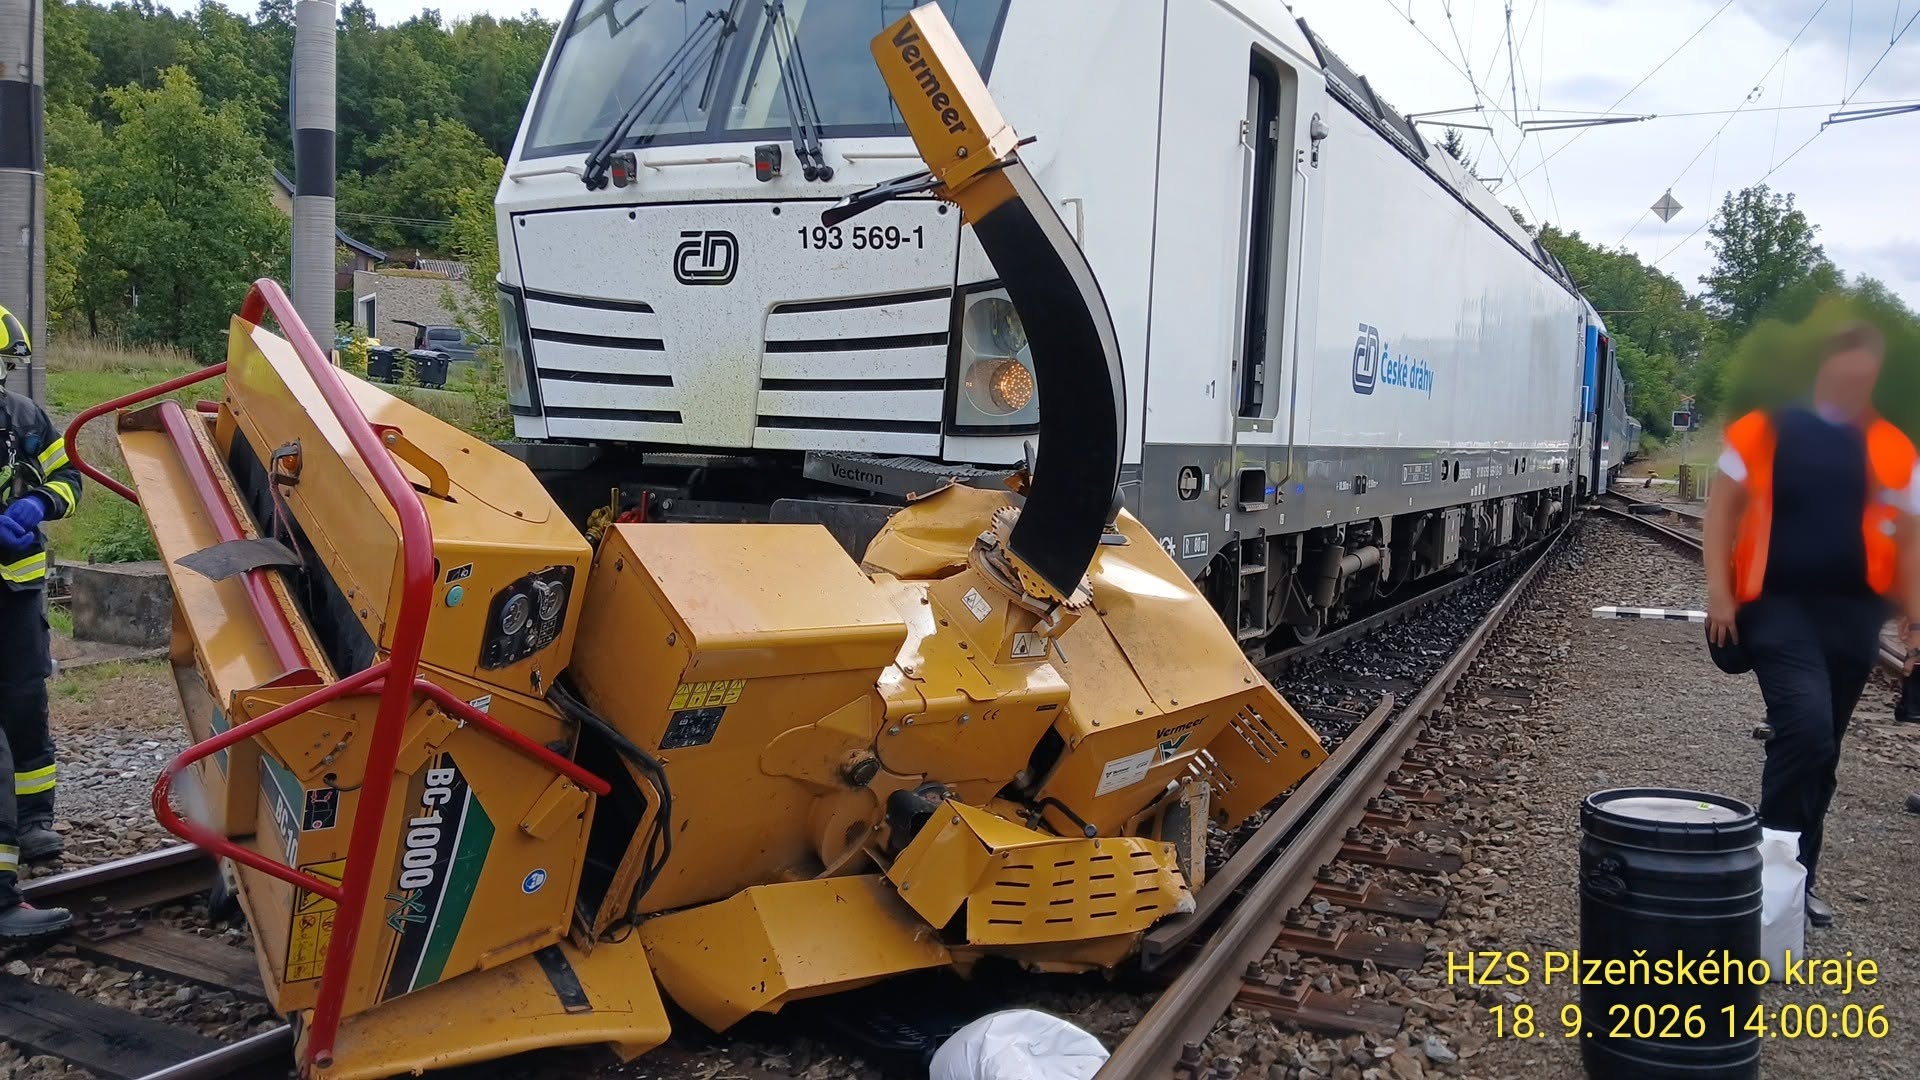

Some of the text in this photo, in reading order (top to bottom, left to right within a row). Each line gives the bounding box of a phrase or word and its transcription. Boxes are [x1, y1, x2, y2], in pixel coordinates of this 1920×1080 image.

[892, 22, 967, 134] Vermeer
[798, 226, 924, 250] 193 569-1
[1381, 342, 1434, 400] České dráhy
[1210, 380, 1216, 399] 1
[831, 462, 883, 486] Vectron
[1156, 715, 1209, 739] Vermeer
